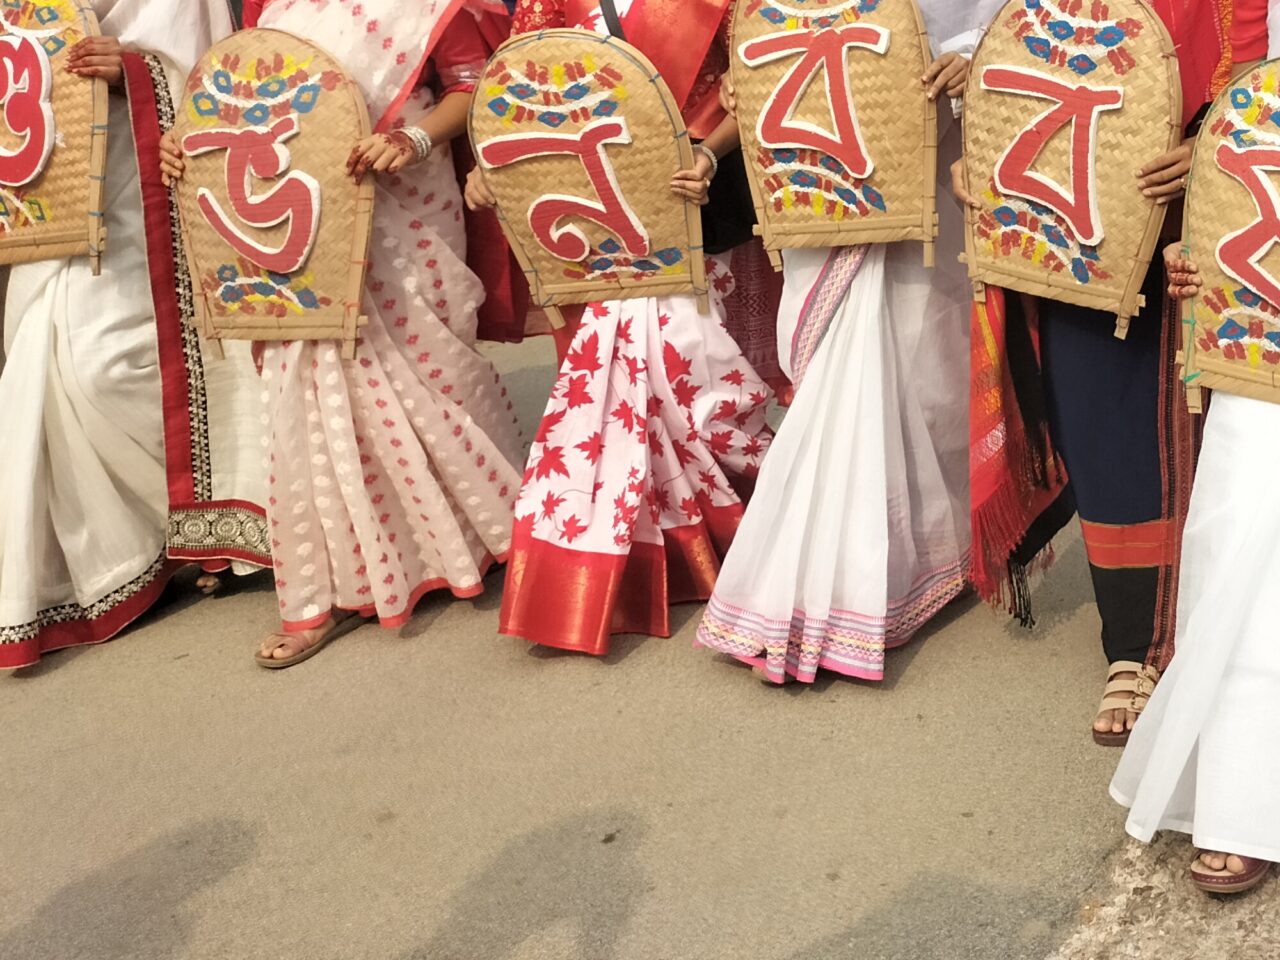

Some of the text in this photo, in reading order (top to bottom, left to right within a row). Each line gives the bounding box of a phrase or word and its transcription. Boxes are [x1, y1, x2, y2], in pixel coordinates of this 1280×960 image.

[737, 23, 891, 180] ব
[980, 64, 1124, 246] ব
[476, 116, 650, 262] ন
